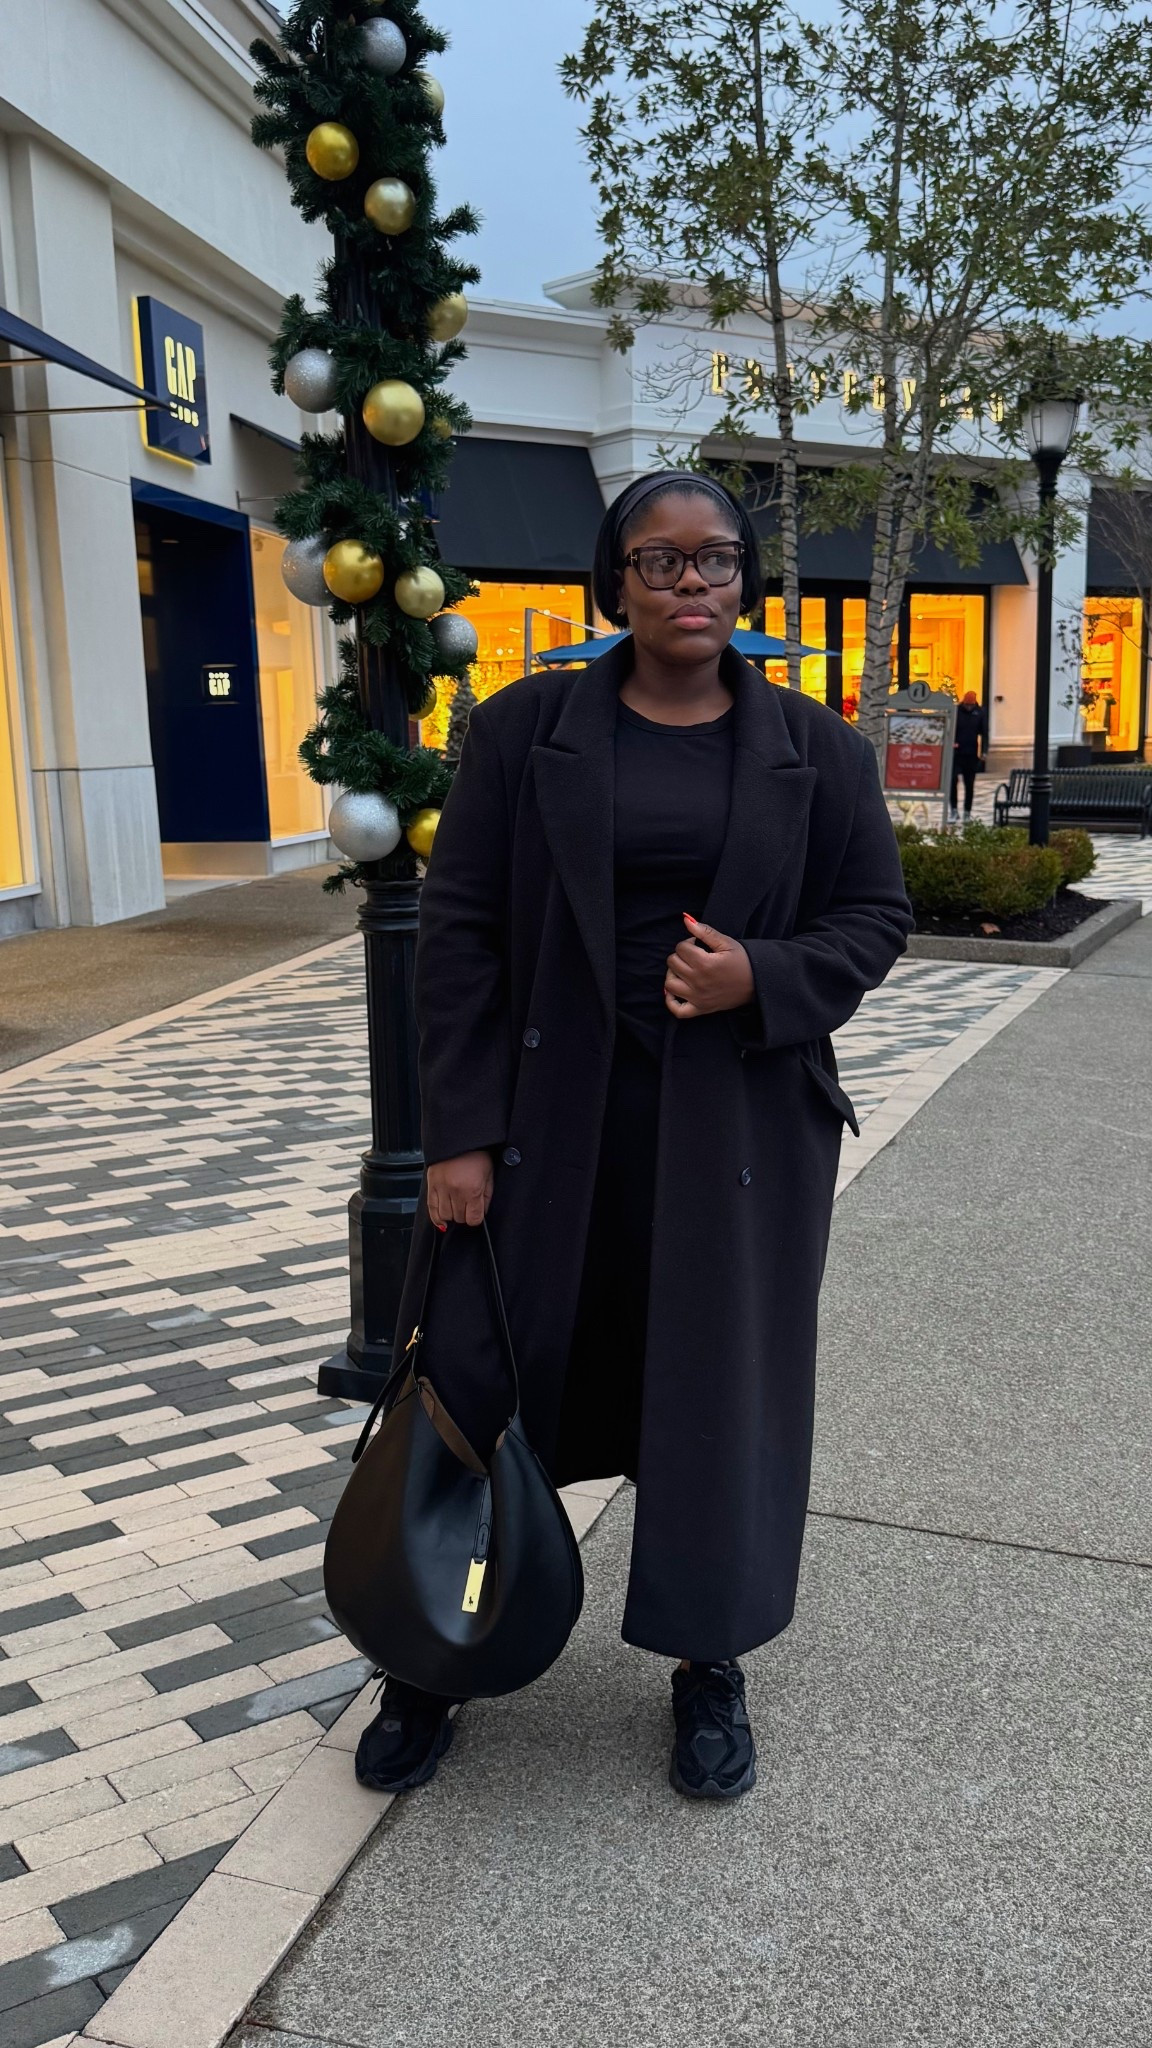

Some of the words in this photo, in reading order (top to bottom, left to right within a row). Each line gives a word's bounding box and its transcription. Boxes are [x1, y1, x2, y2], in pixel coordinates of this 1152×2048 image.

[164, 335, 197, 404] GAP
[711, 351, 917, 412] PTERY
[208, 678, 231, 696] GAP
